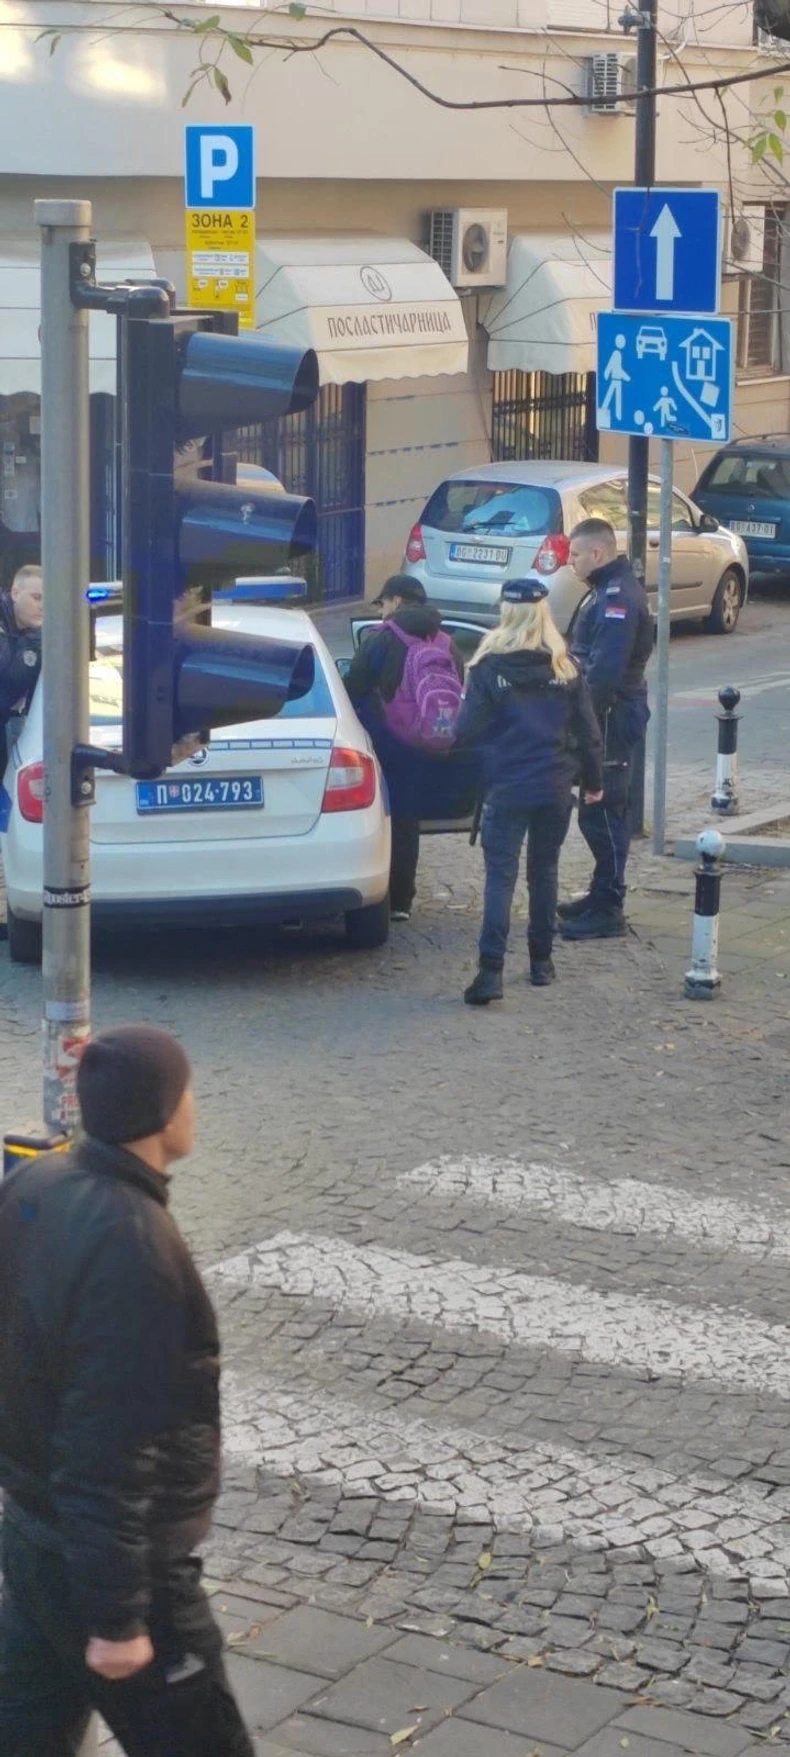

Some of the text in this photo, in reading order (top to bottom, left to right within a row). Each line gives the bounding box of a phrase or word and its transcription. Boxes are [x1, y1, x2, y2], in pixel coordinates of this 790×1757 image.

[200, 135, 239, 198] P
[191, 213, 248, 228] ЗОНА 2
[327, 312, 452, 338] ПОСЛАСТИЧАРНИЦА
